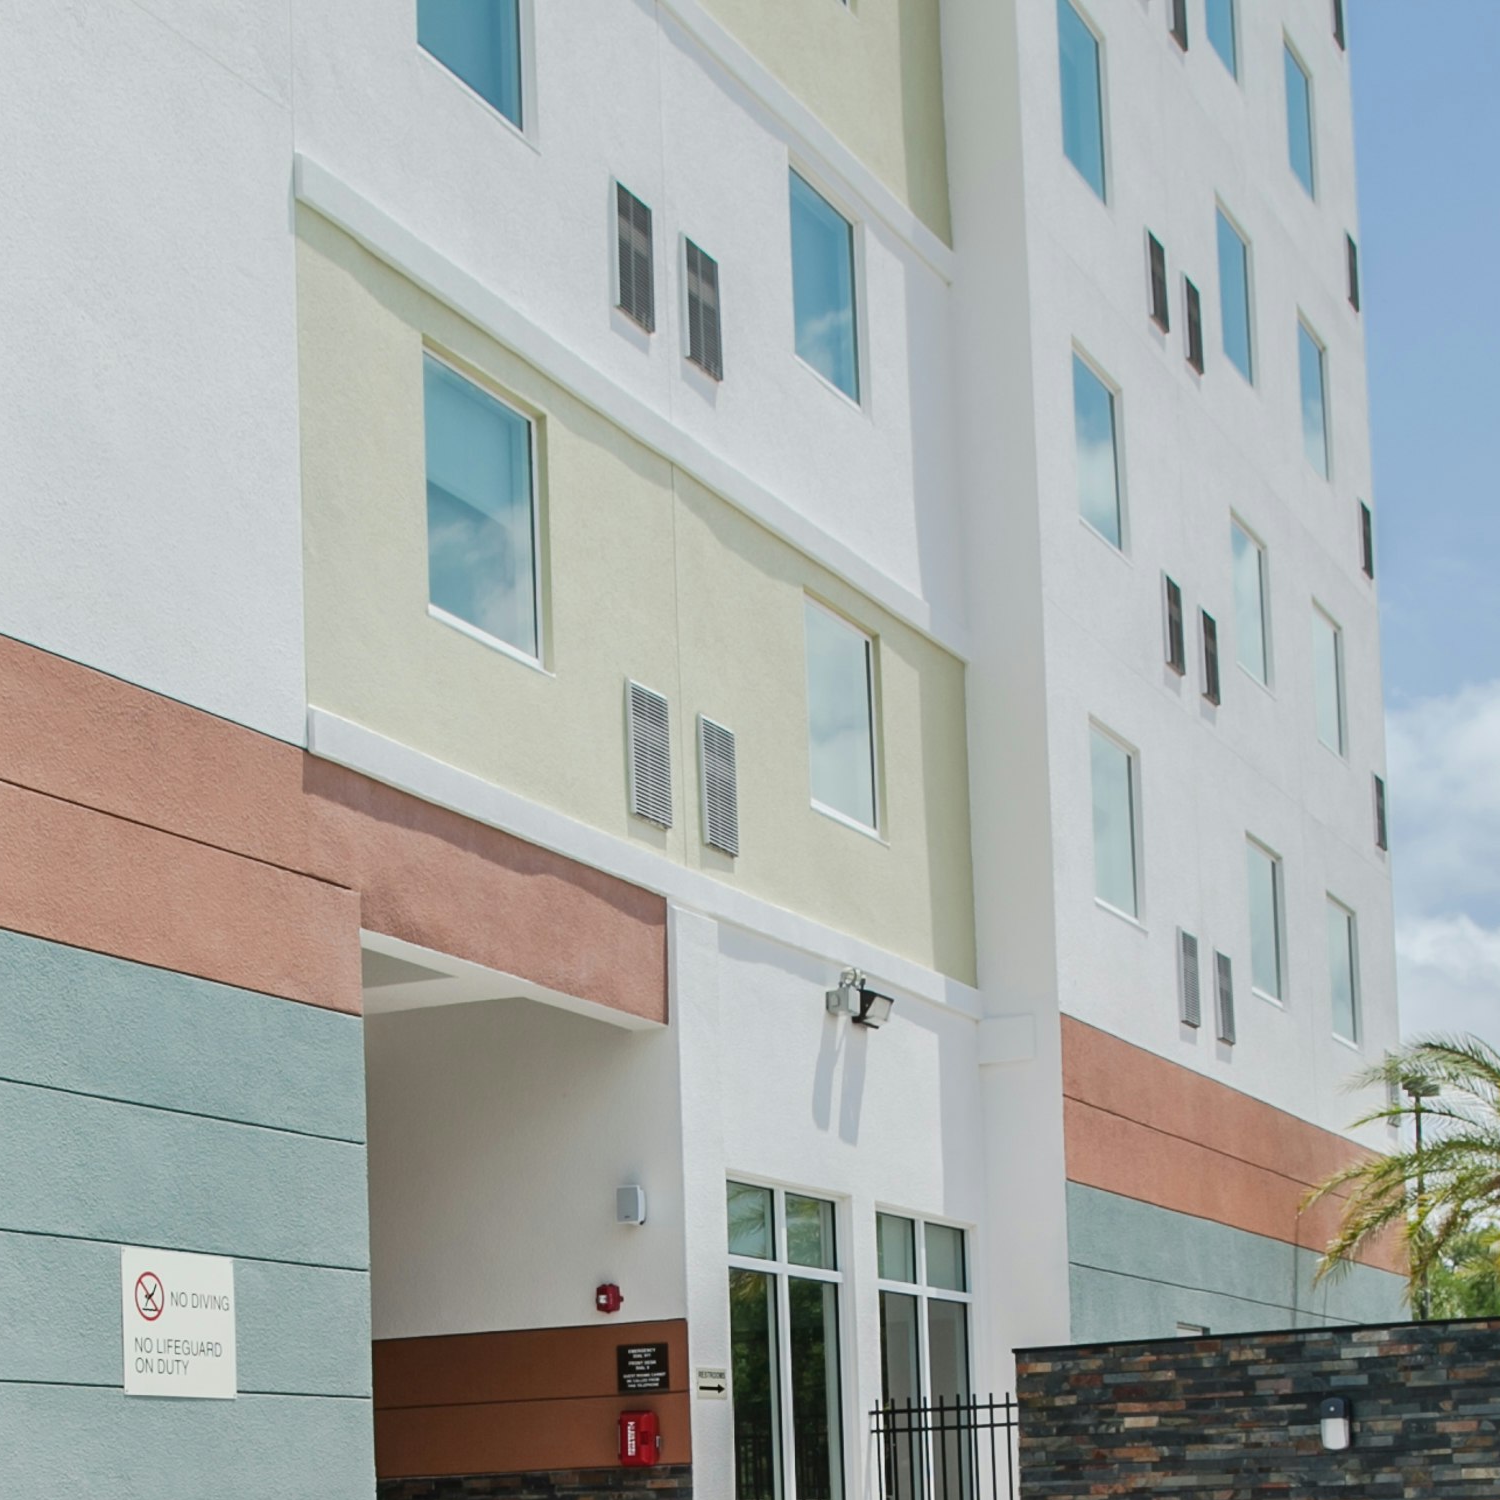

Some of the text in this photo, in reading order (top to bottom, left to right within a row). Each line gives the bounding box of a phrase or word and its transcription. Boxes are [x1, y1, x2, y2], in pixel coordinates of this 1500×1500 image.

[170, 1291, 230, 1311] NO DIVING
[134, 1337, 222, 1358] NO LIFEGUARD
[135, 1357, 190, 1375] ON DUTY
[698, 1370, 726, 1379] RESTROOMS
